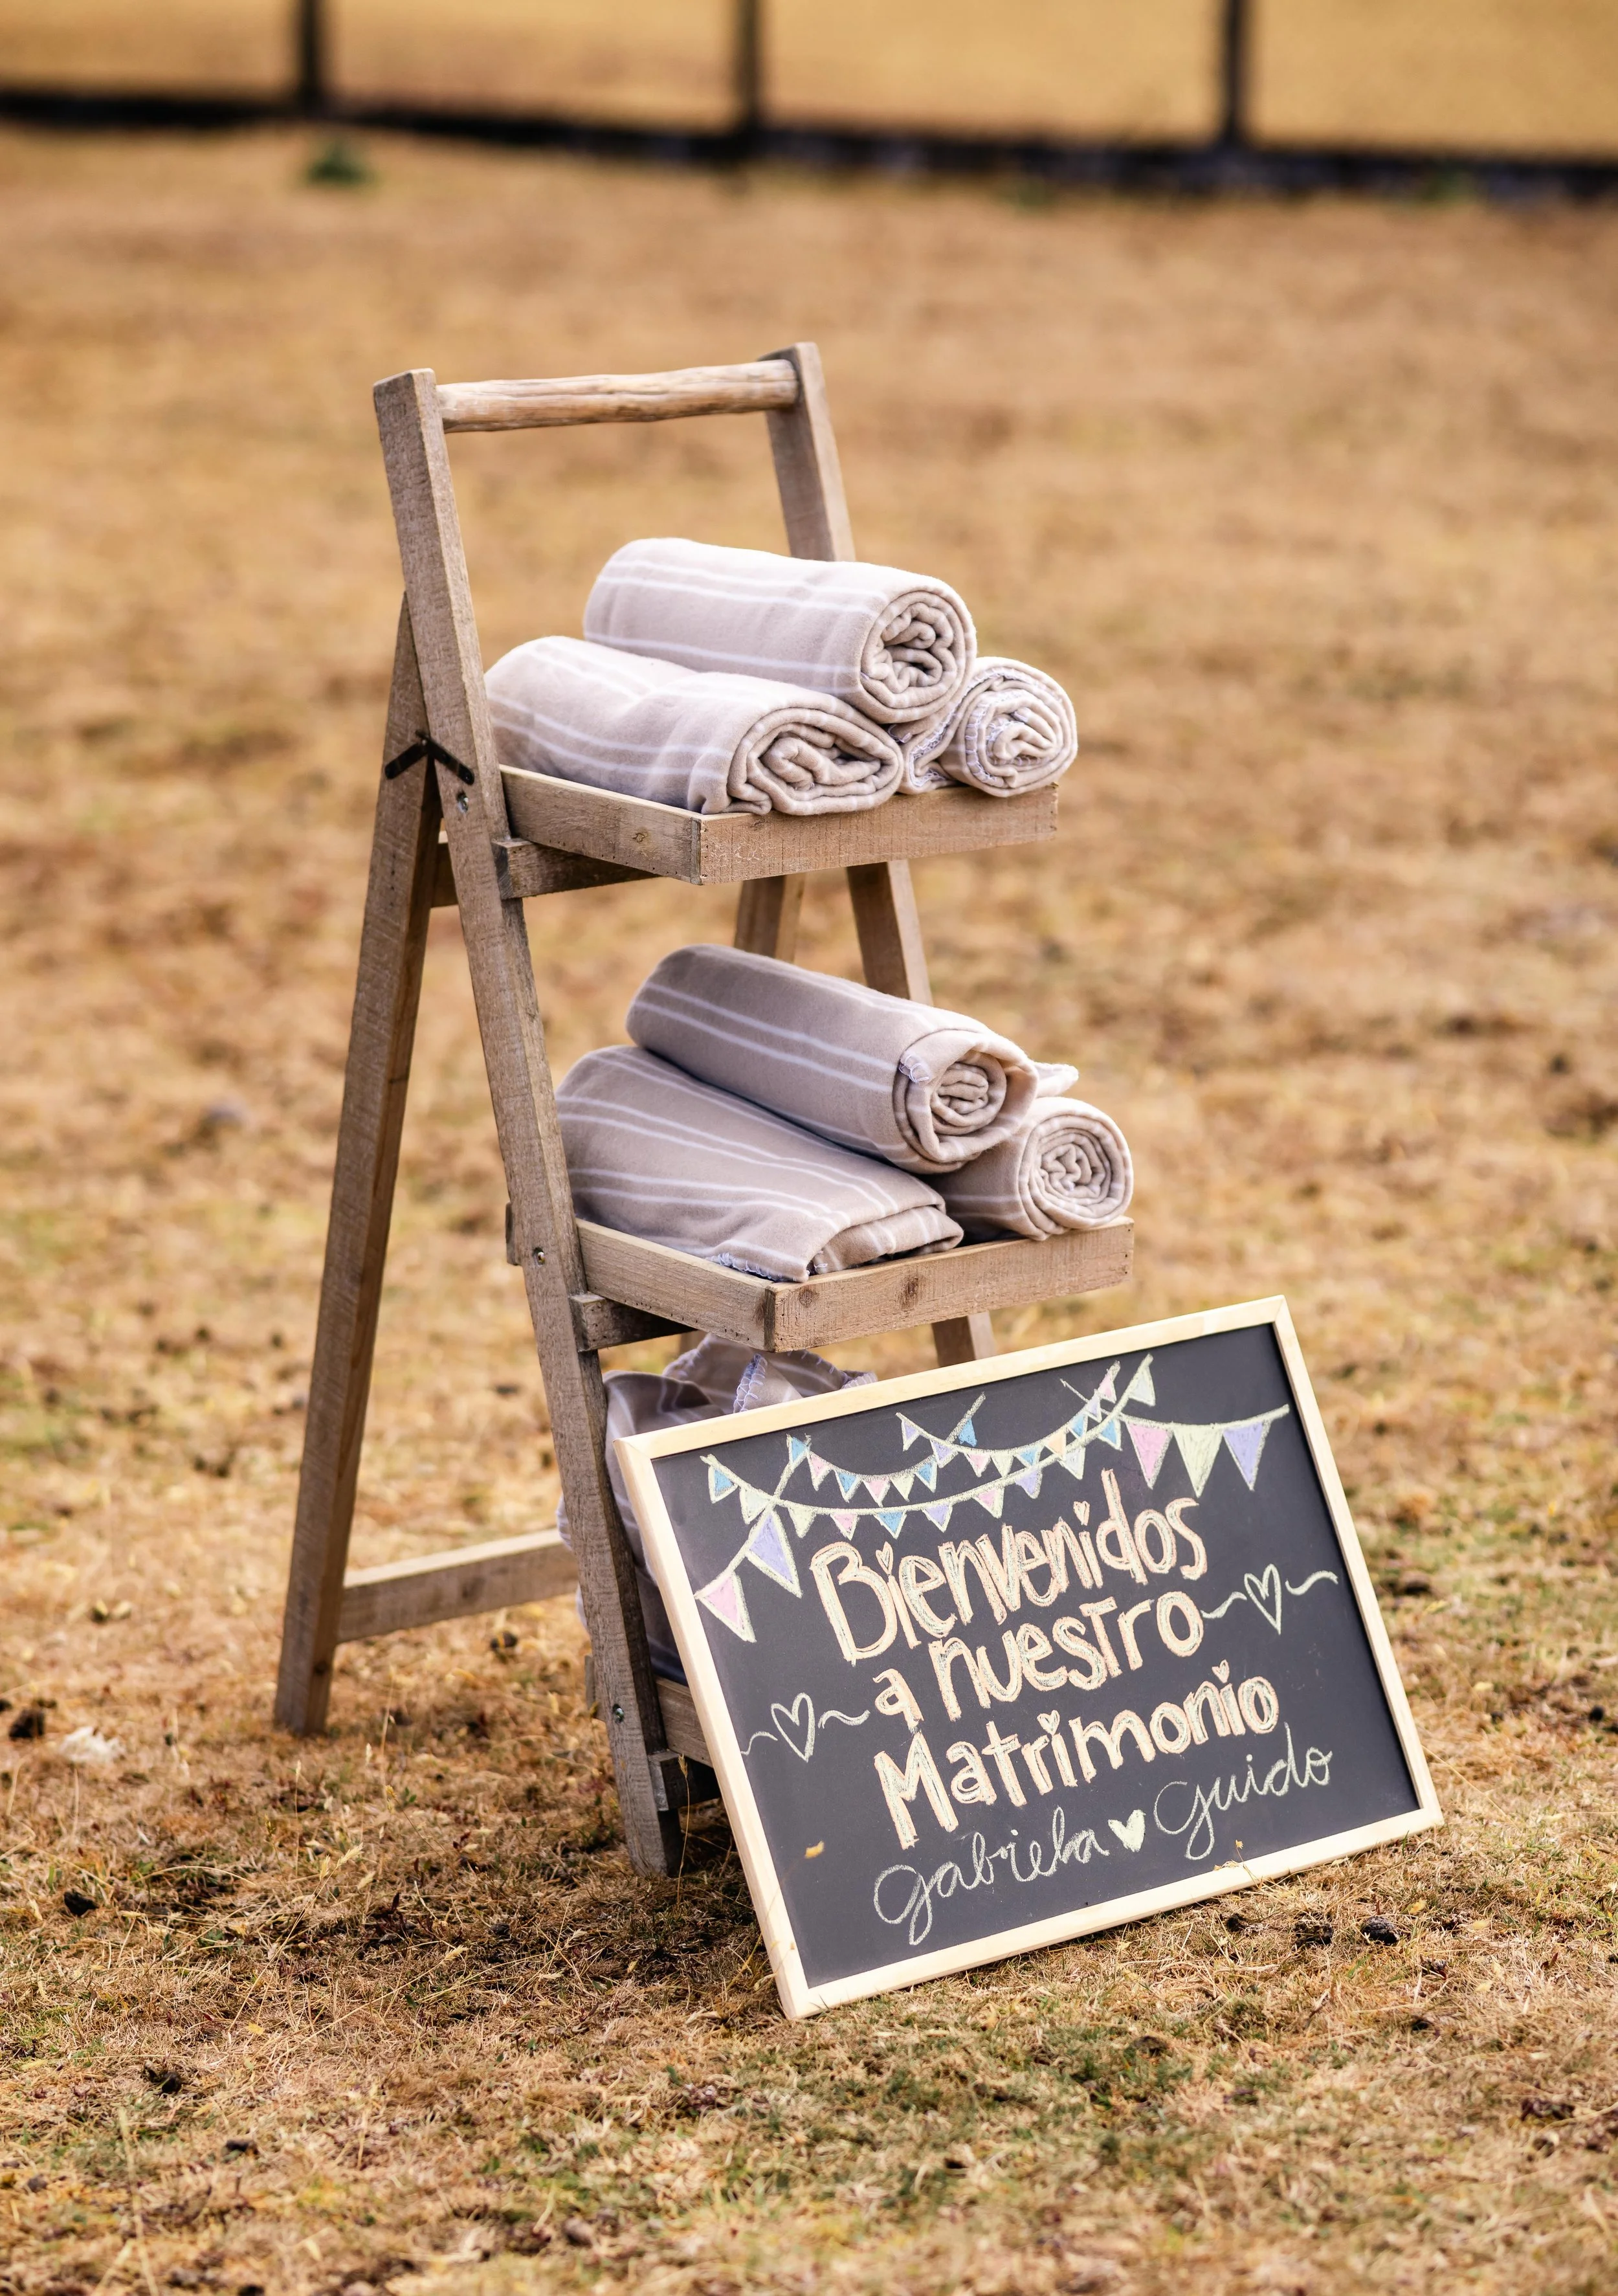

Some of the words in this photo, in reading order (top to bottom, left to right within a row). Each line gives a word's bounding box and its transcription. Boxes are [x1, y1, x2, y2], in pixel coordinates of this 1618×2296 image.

[811, 1469, 1207, 1666] Bienvenidos
[873, 1668, 924, 1728] a
[928, 1591, 1204, 1721] nuestro
[874, 1660, 1280, 1849] Matrimonio
